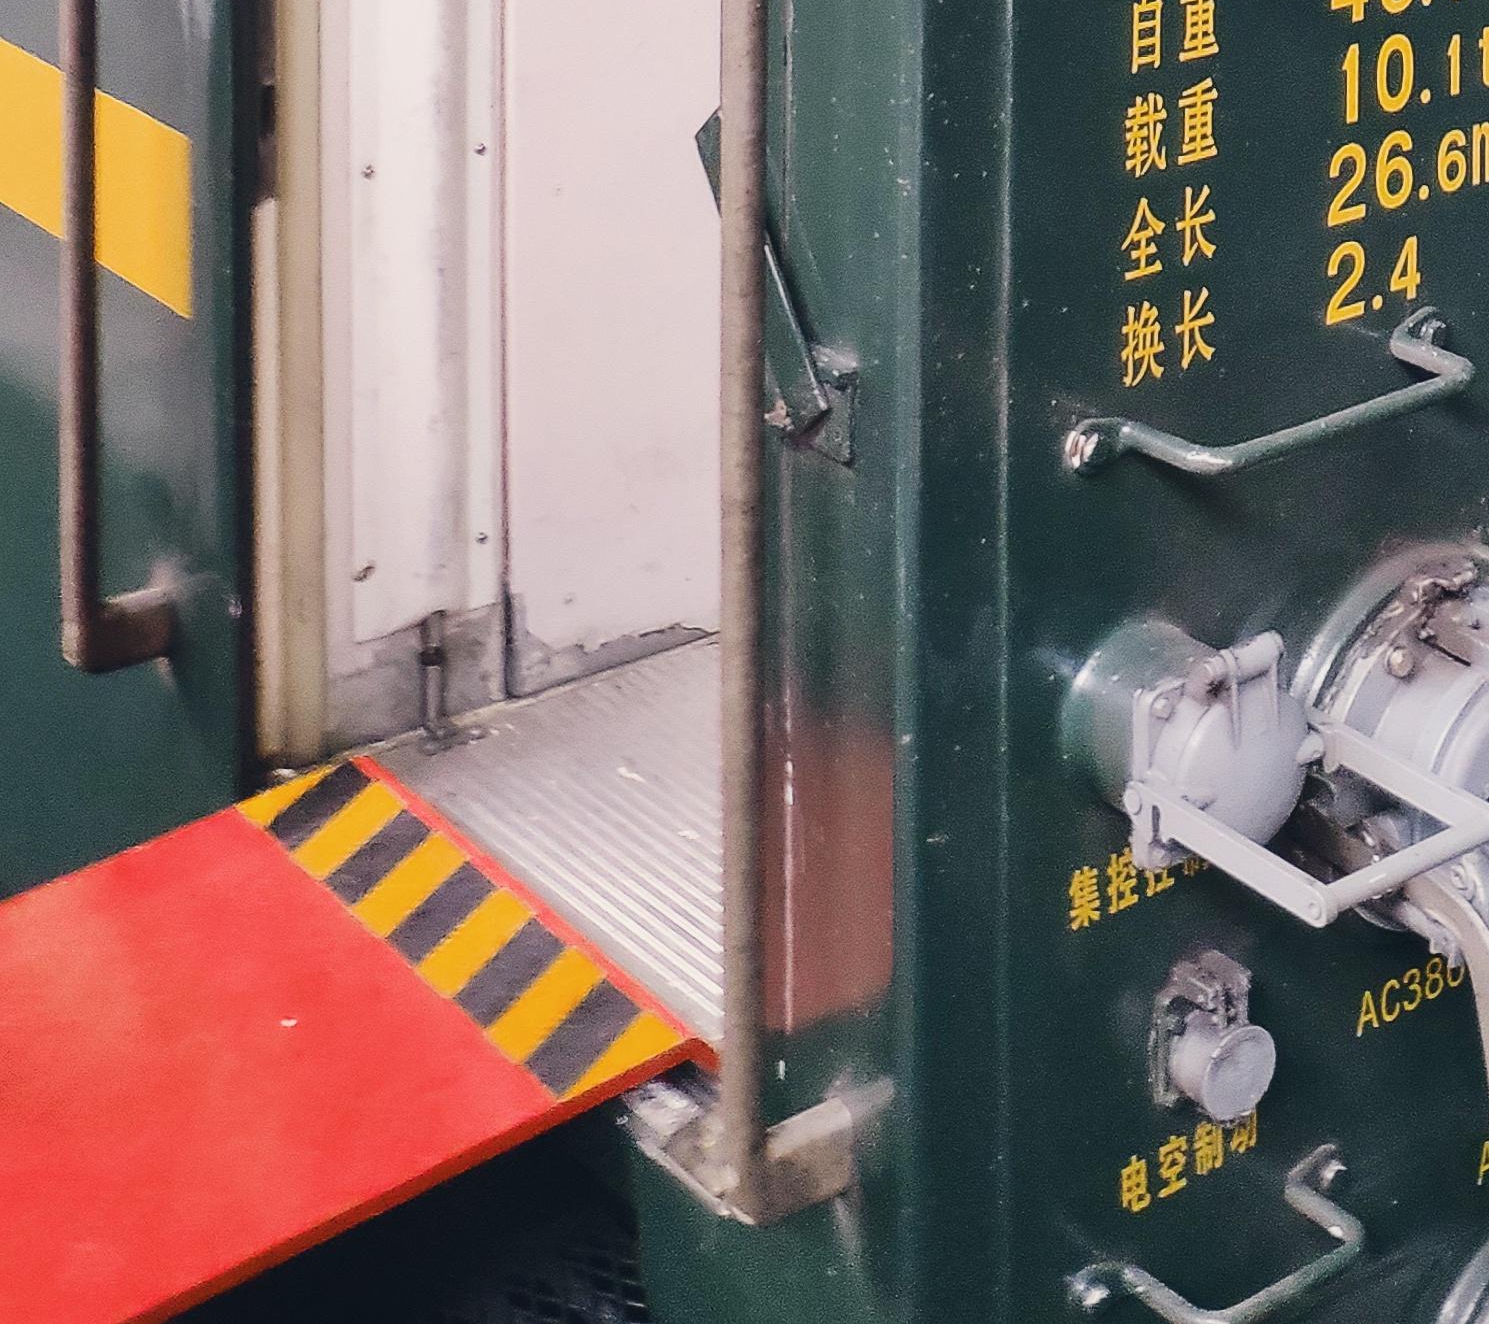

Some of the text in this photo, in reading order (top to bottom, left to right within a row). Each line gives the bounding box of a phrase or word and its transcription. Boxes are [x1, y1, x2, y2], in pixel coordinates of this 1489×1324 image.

[1123, 77, 1220, 179] 载重
[1121, 184, 1217, 282] 全长
[1120, 234, 1422, 388] 换长 2.4
[1068, 847, 1211, 932] 集控
